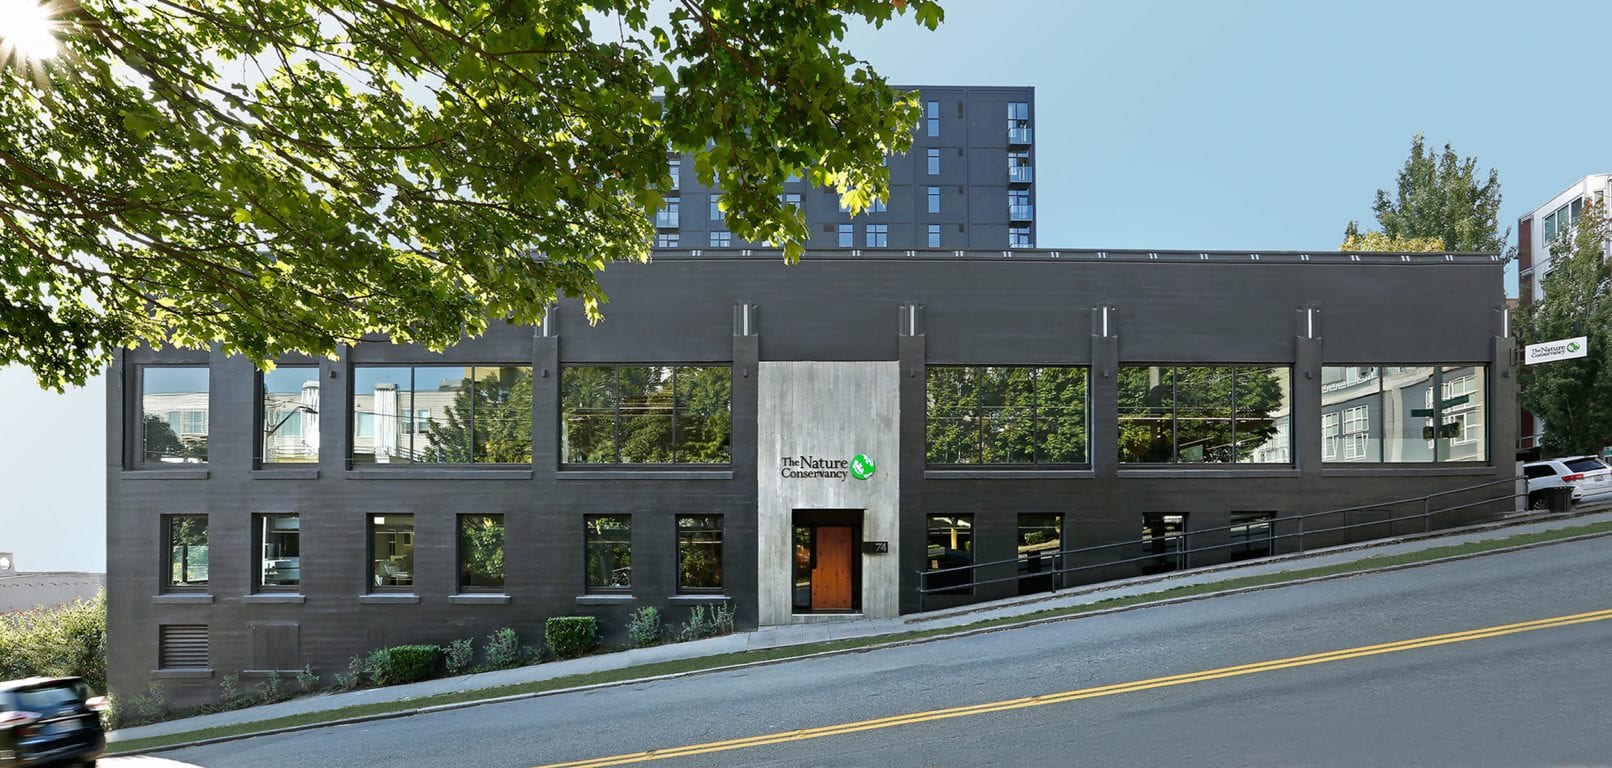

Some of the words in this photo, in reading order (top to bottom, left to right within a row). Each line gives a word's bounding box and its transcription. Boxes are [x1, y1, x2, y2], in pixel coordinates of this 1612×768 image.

[781, 457, 799, 466] The
[800, 455, 848, 469] Nature
[781, 468, 848, 482] Conservancy
[875, 543, 886, 552] 74
